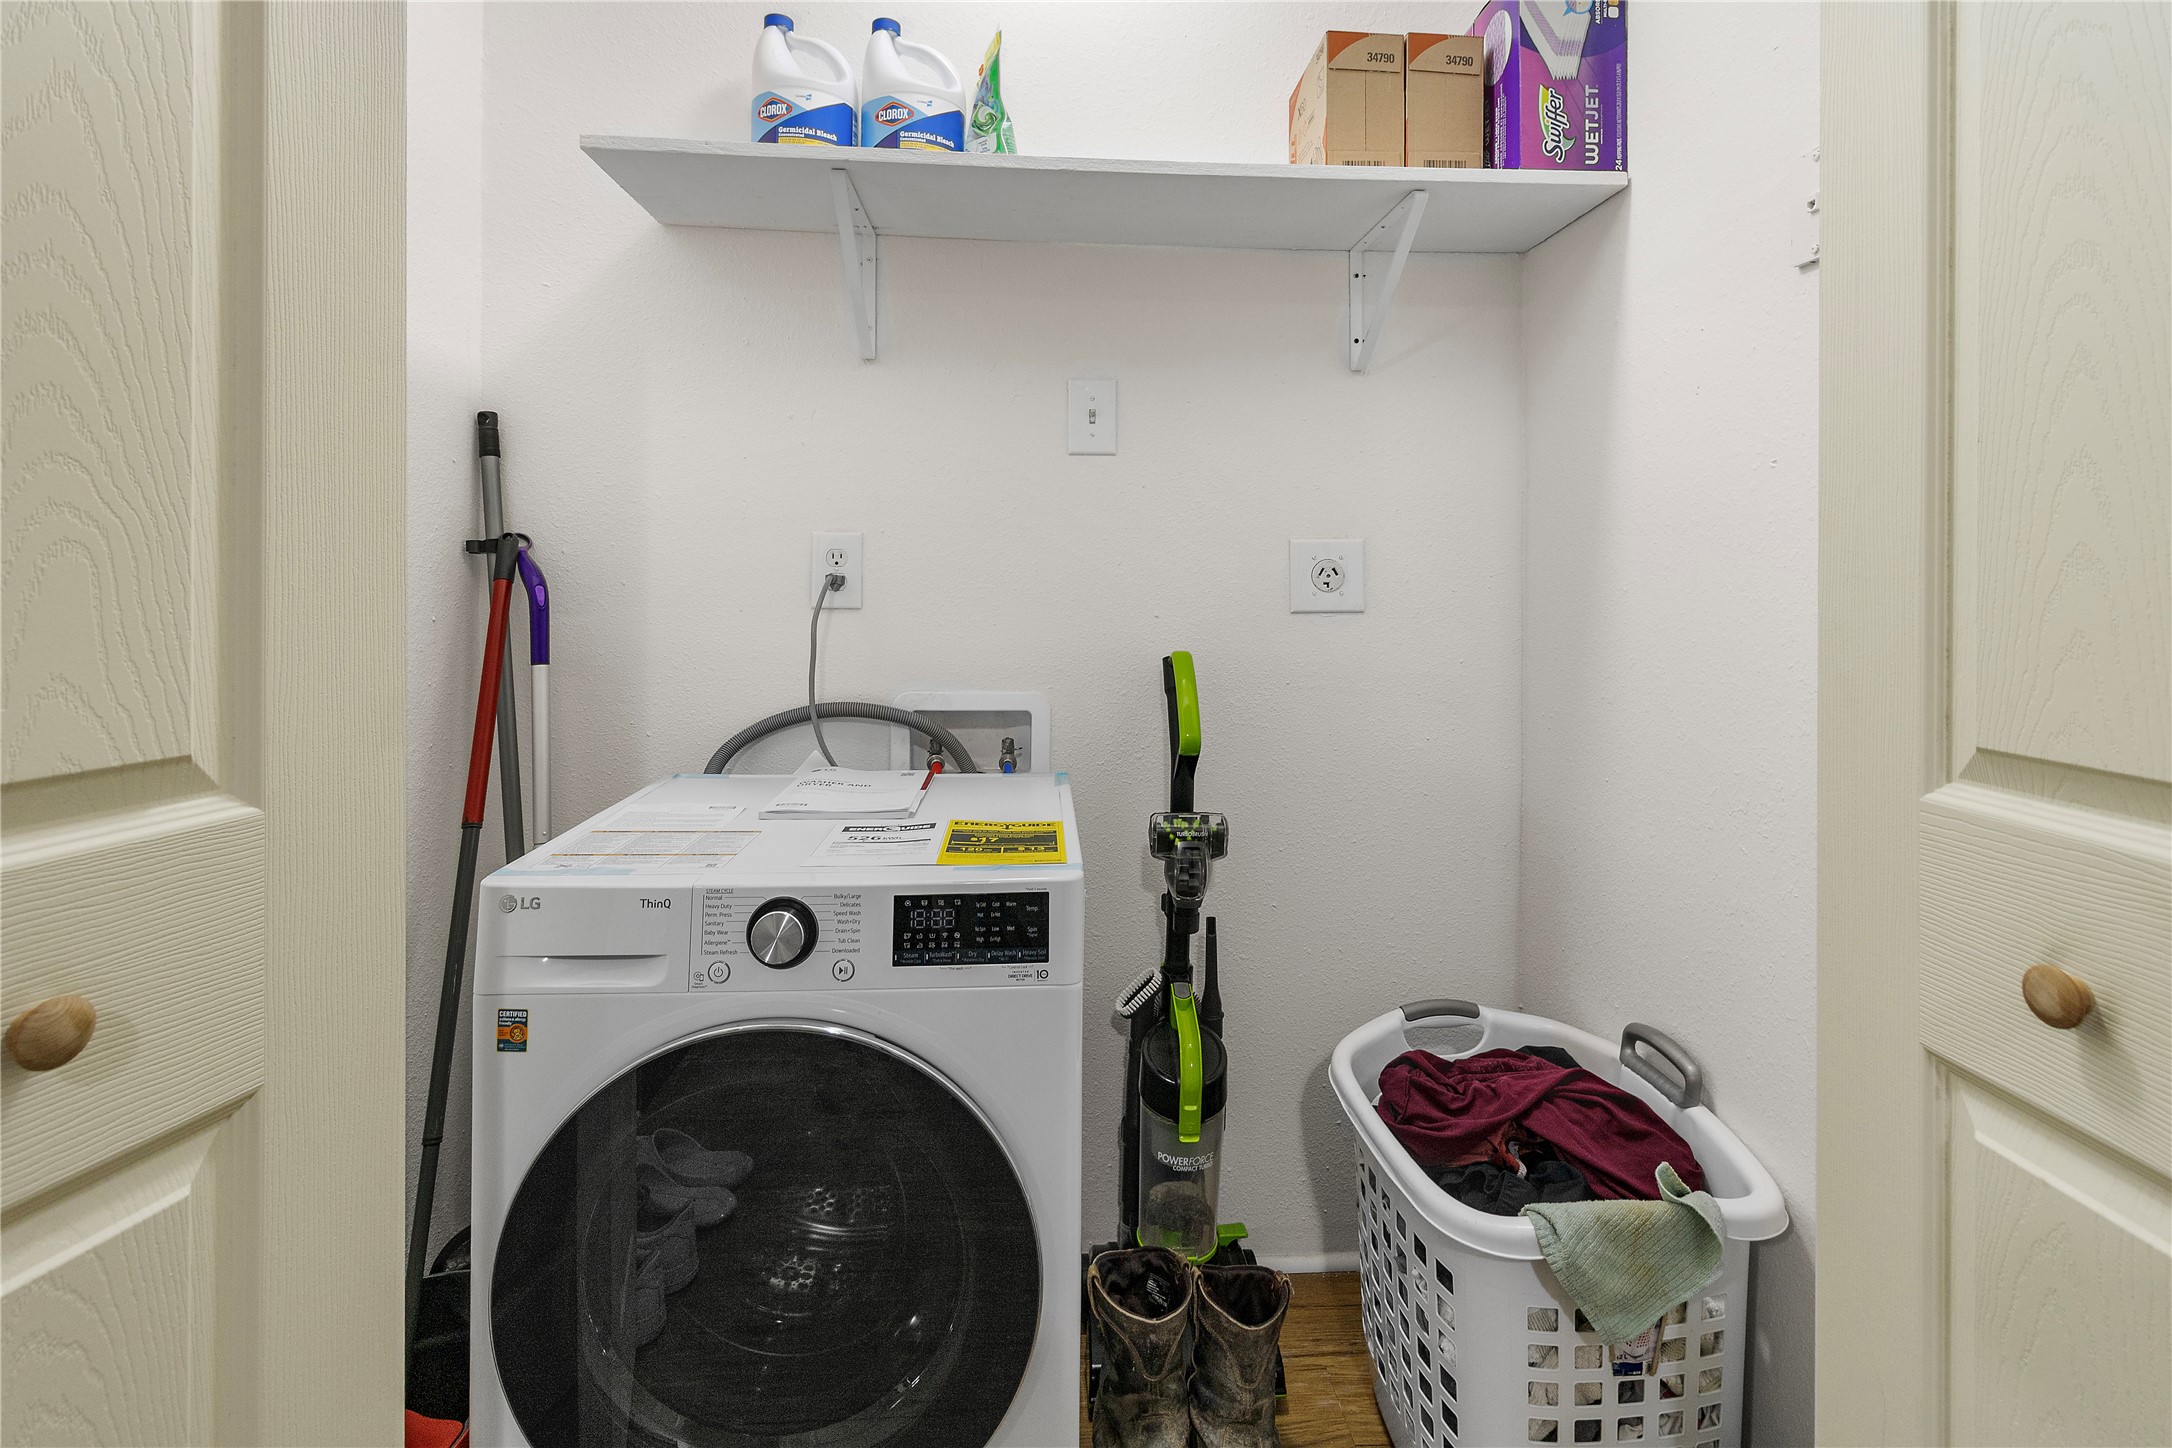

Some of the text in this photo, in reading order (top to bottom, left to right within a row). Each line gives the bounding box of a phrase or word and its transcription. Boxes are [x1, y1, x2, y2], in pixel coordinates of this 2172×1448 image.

[1366, 52, 1395, 63] 34790
[1446, 55, 1474, 66] 34790
[760, 103, 787, 118] CLOROX
[878, 108, 908, 122] CLOROX
[1542, 89, 1570, 163] Swiffer
[778, 126, 838, 141] Germicidal Bleach
[900, 131, 936, 140] Germicidal
[937, 136, 954, 148] Bleach
[1615, 160, 1622, 170] 24
[640, 898, 671, 909] ThinQ
[1157, 1151, 1214, 1166] POWERFORCE
